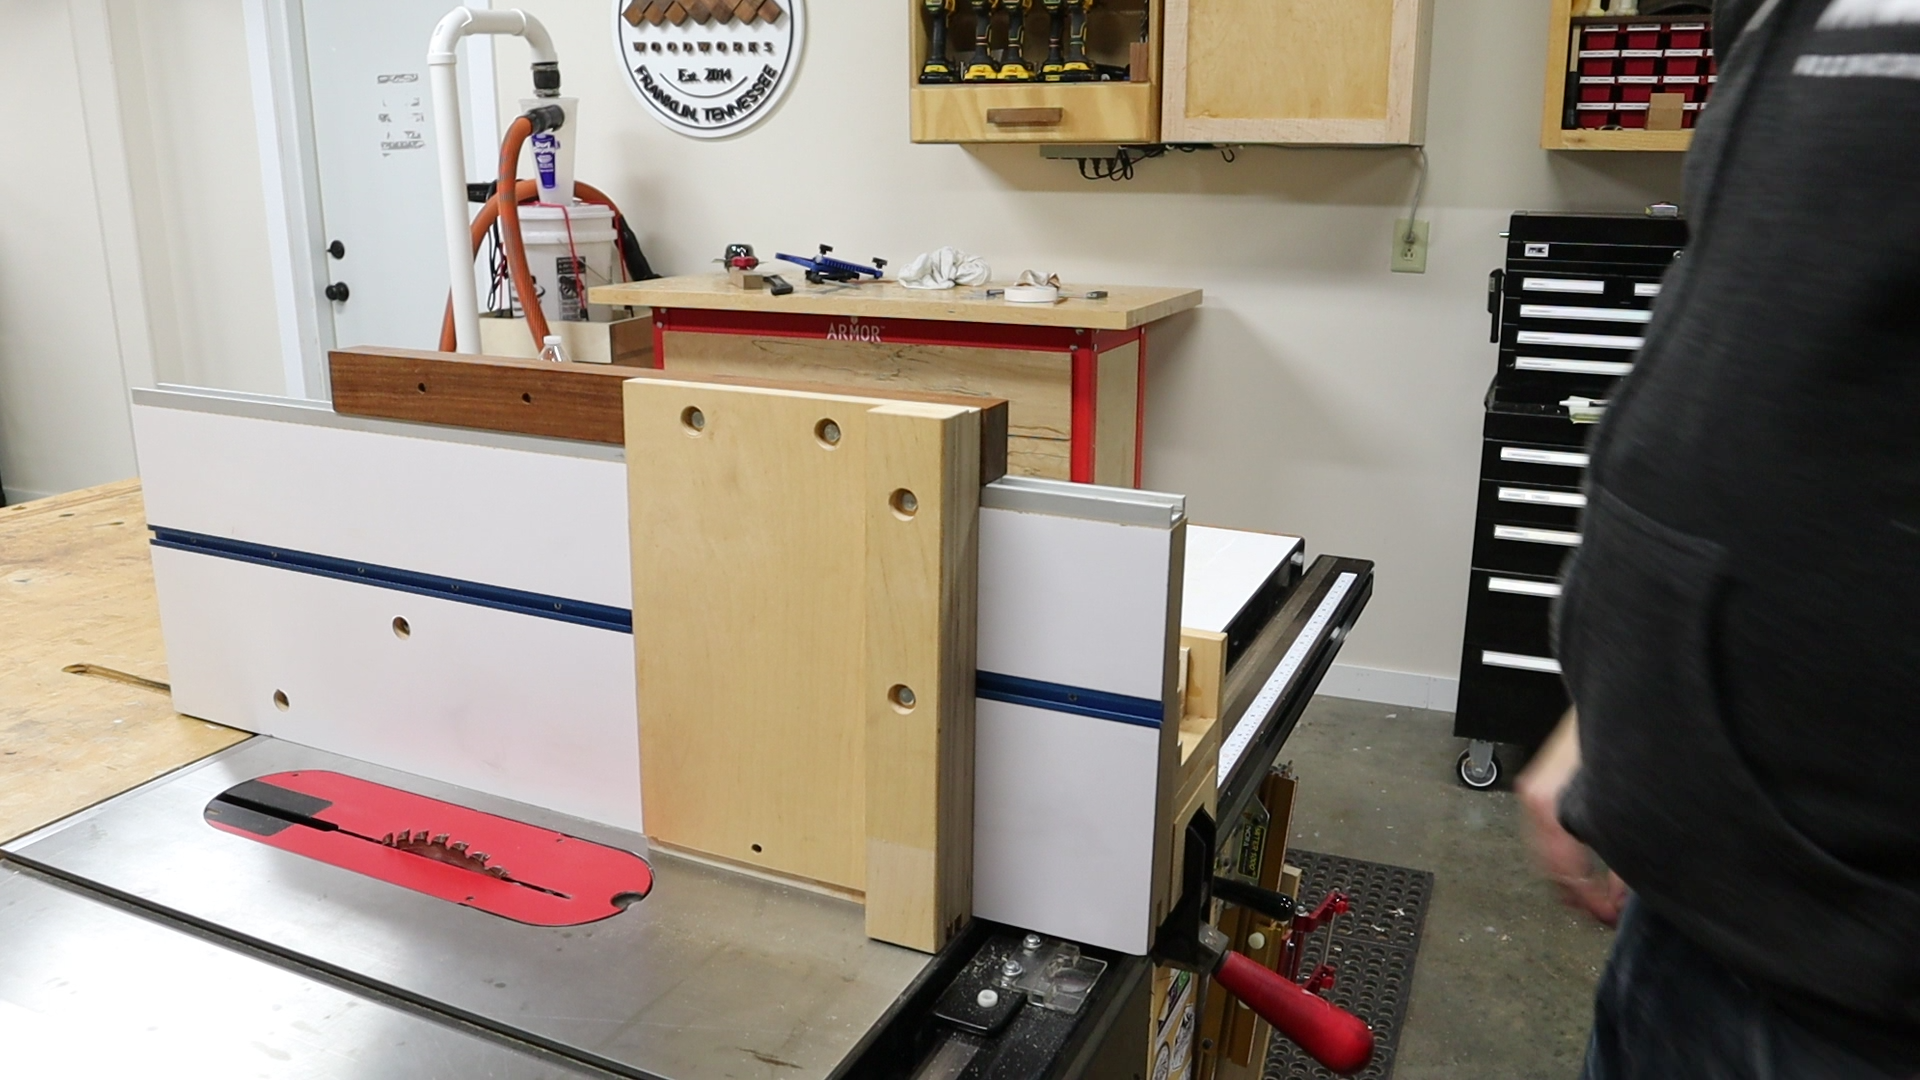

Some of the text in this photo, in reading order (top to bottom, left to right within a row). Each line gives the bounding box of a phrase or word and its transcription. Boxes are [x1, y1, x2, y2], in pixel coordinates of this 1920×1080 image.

[632, 41, 773, 53] WOODWORKS
[678, 68, 732, 82] Est. 2014
[634, 64, 777, 122] FRANKLIN, TENNESSEE
[826, 322, 881, 342] ARMOR
